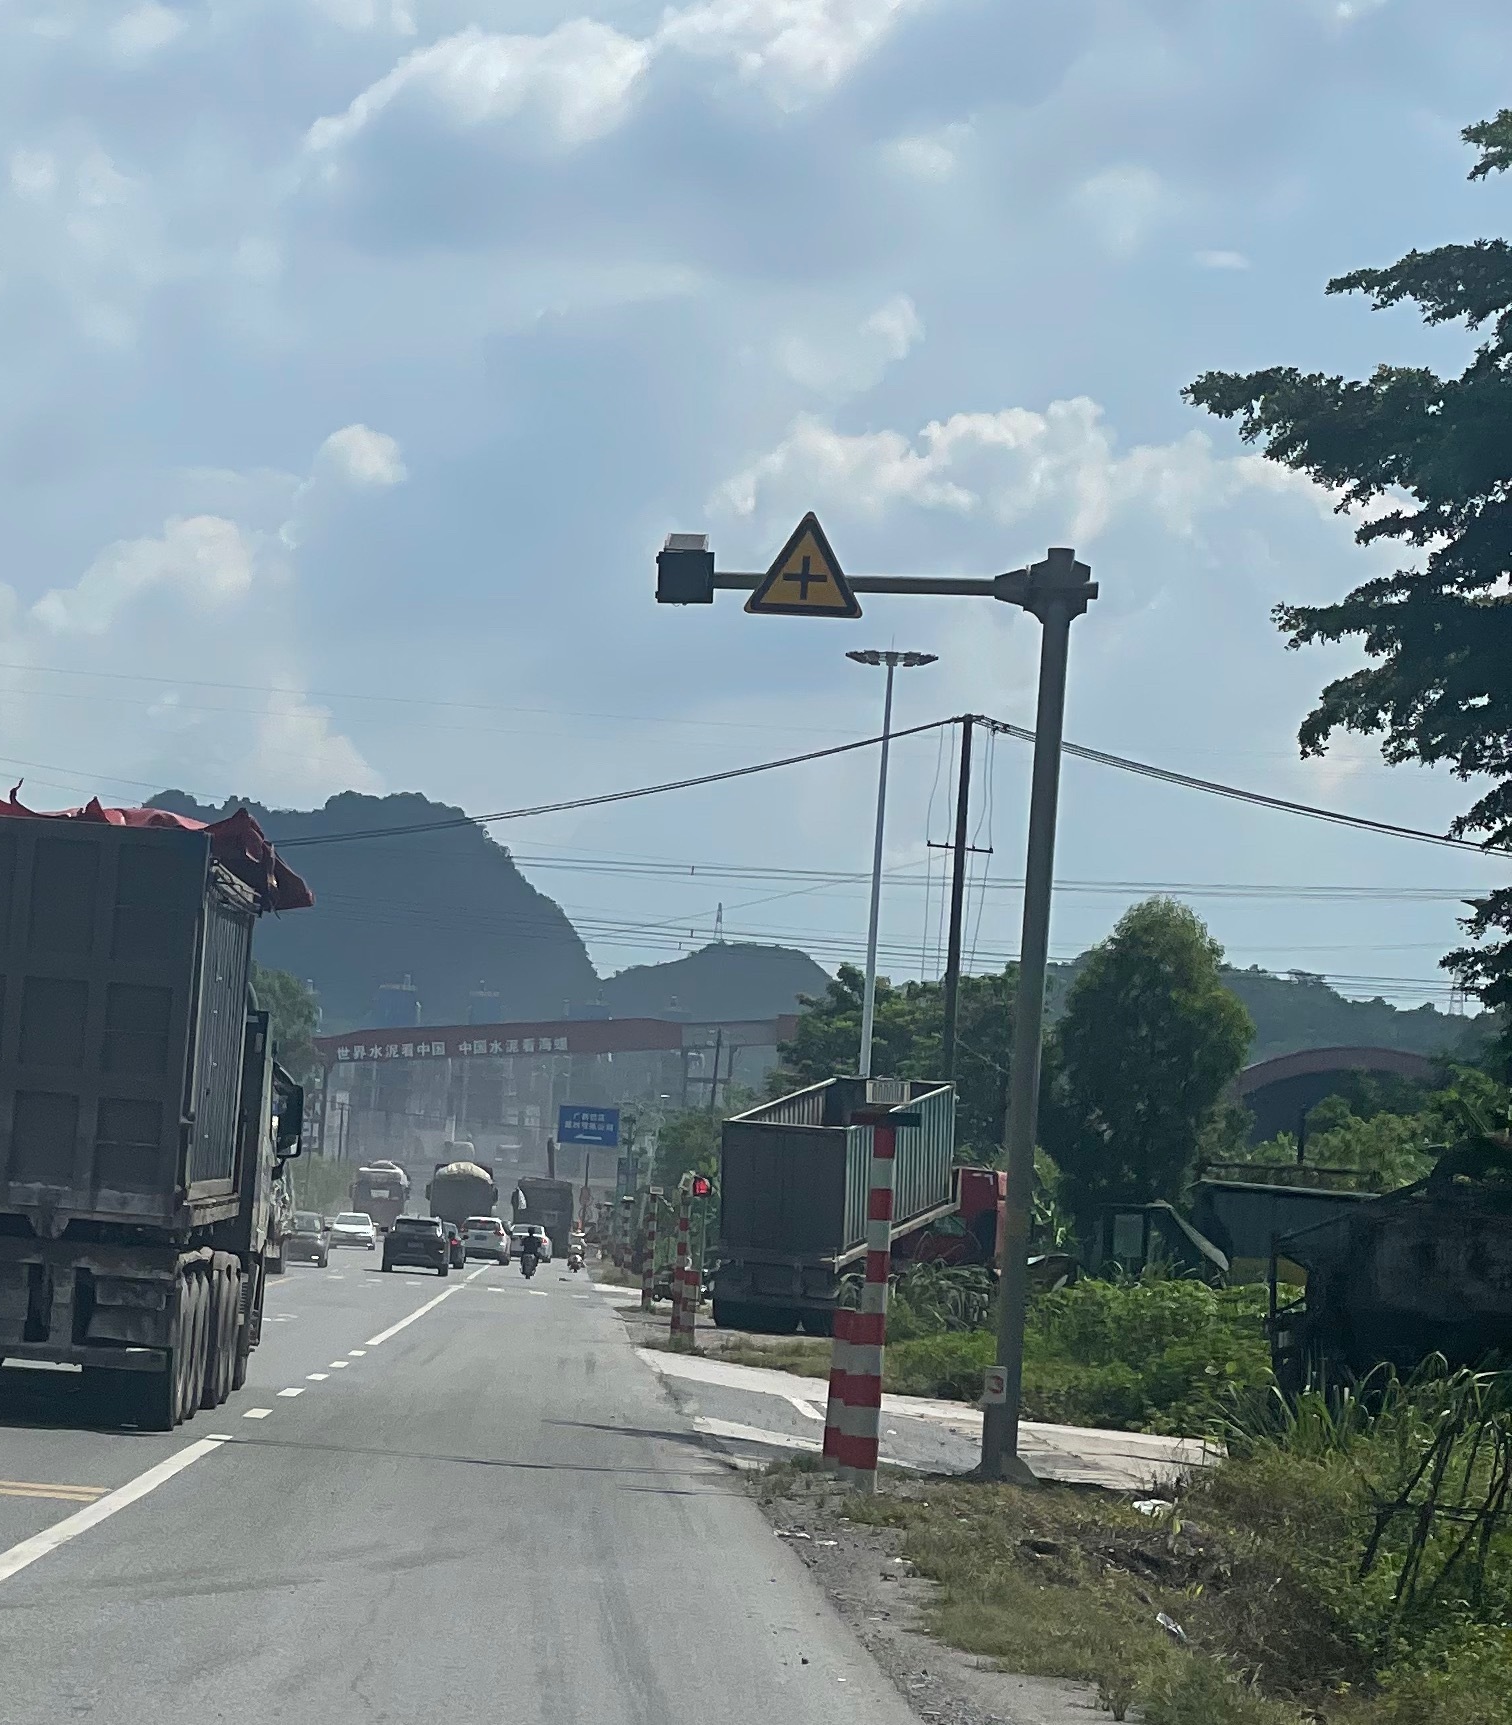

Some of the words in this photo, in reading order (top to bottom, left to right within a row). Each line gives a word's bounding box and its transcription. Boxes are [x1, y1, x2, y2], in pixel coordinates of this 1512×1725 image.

[337, 1041, 446, 1061] 世界水泥看中国
